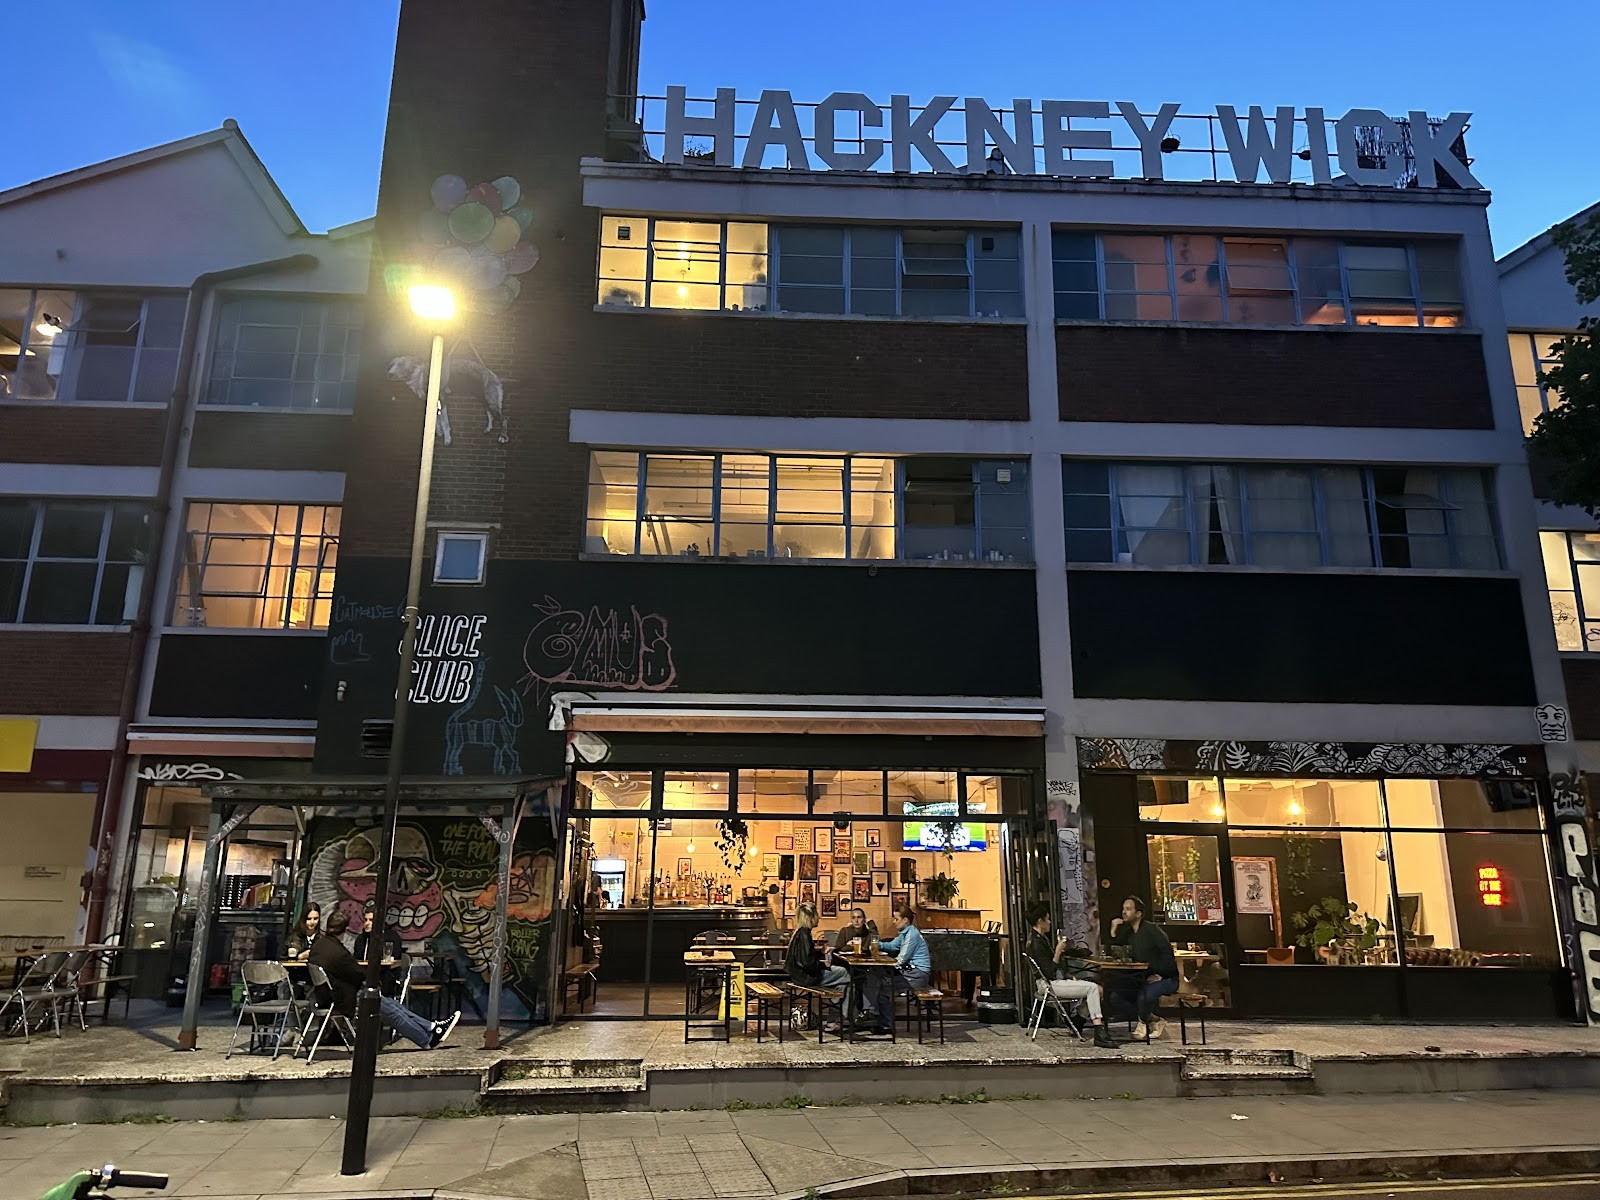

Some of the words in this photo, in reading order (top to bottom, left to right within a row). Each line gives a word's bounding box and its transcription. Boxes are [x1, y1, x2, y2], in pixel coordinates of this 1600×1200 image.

[663, 85, 1181, 179] HACKNEY
[1215, 104, 1486, 190] WICK
[438, 839, 467, 856] THE
